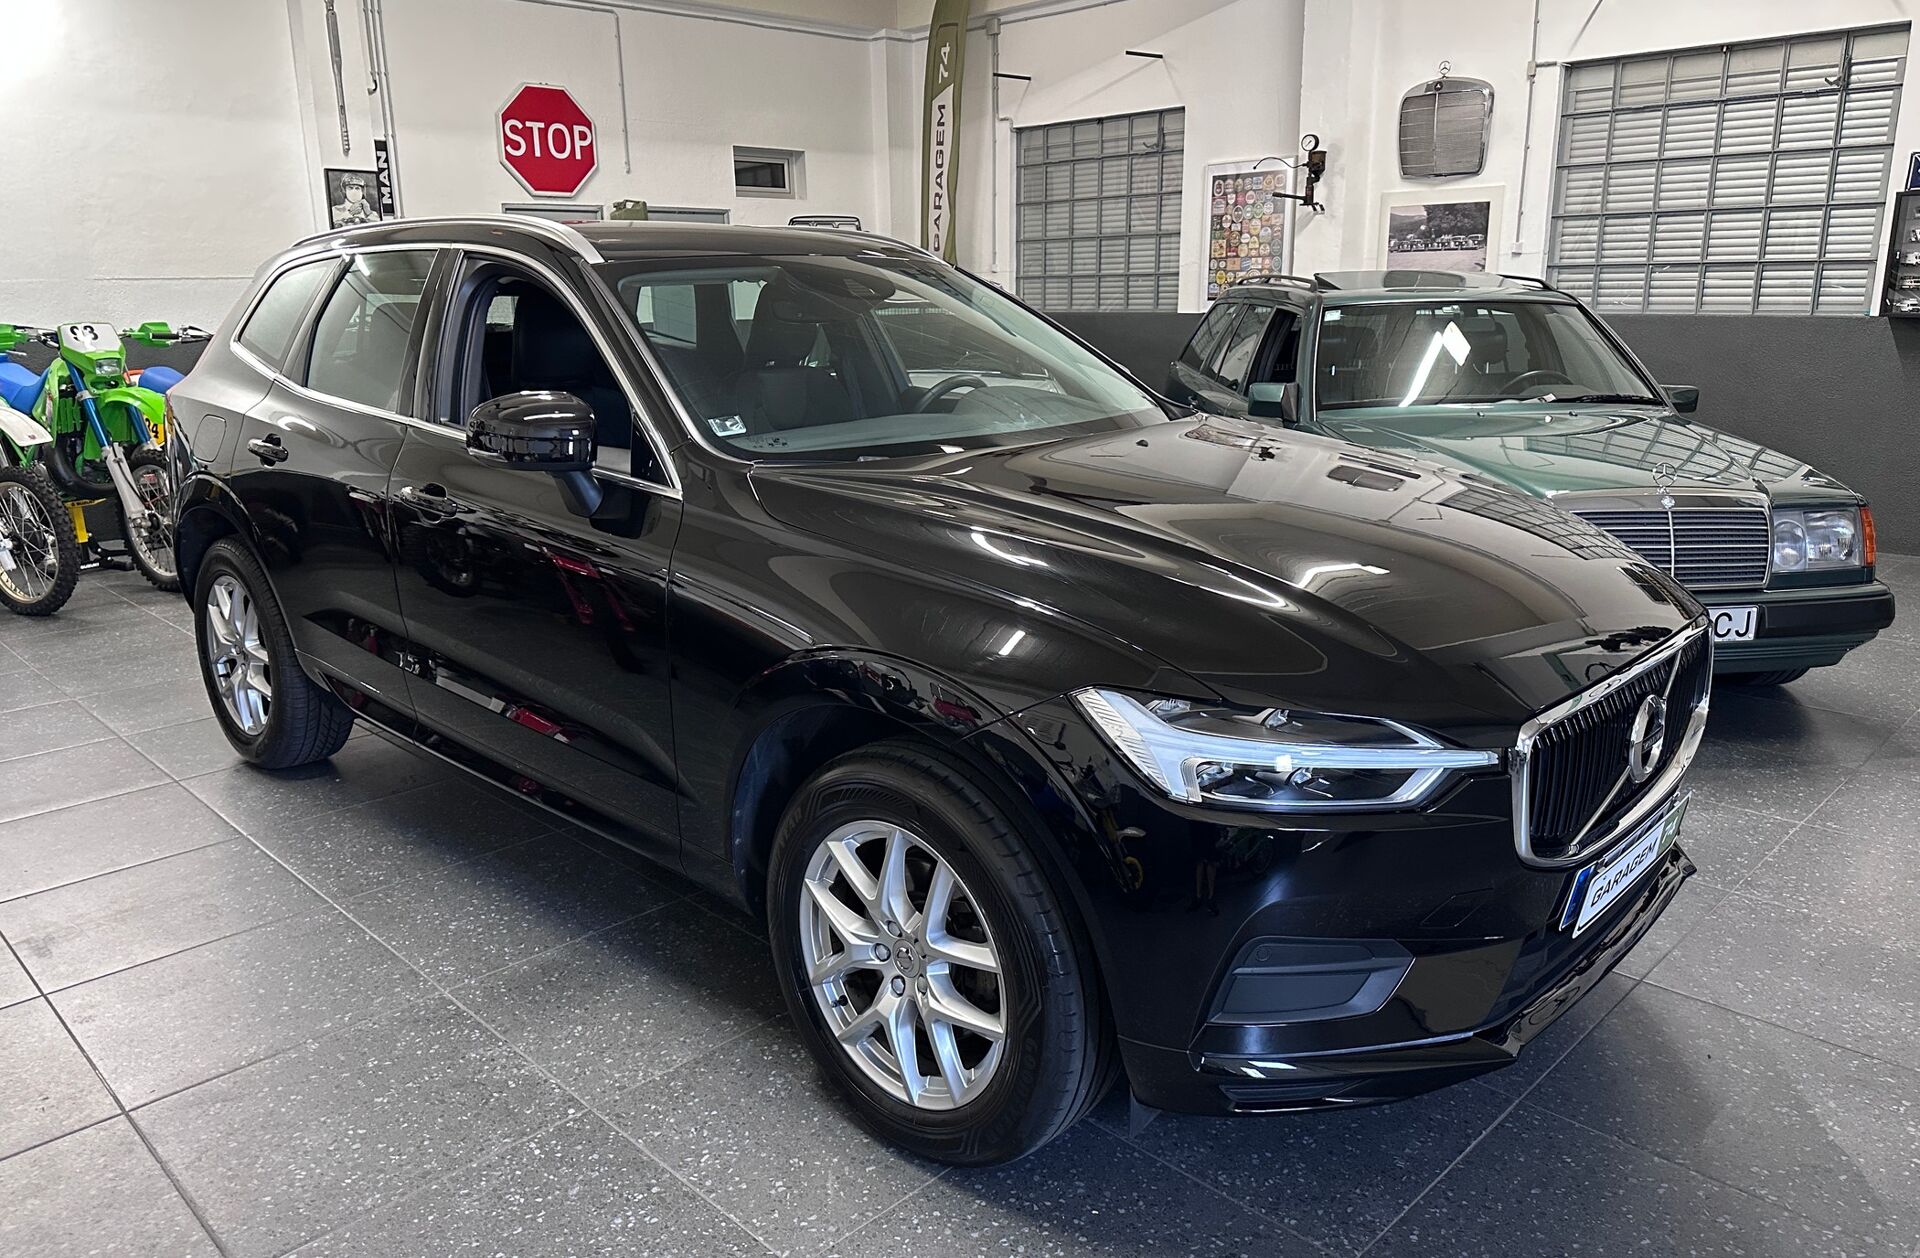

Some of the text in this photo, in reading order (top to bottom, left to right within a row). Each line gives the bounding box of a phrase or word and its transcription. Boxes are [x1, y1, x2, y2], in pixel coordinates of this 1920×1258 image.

[504, 119, 592, 160] STOP
[933, 42, 950, 252] GARAGEM 74
[376, 151, 392, 204] MAN
[1590, 815, 1679, 908] GARAGEM 74
